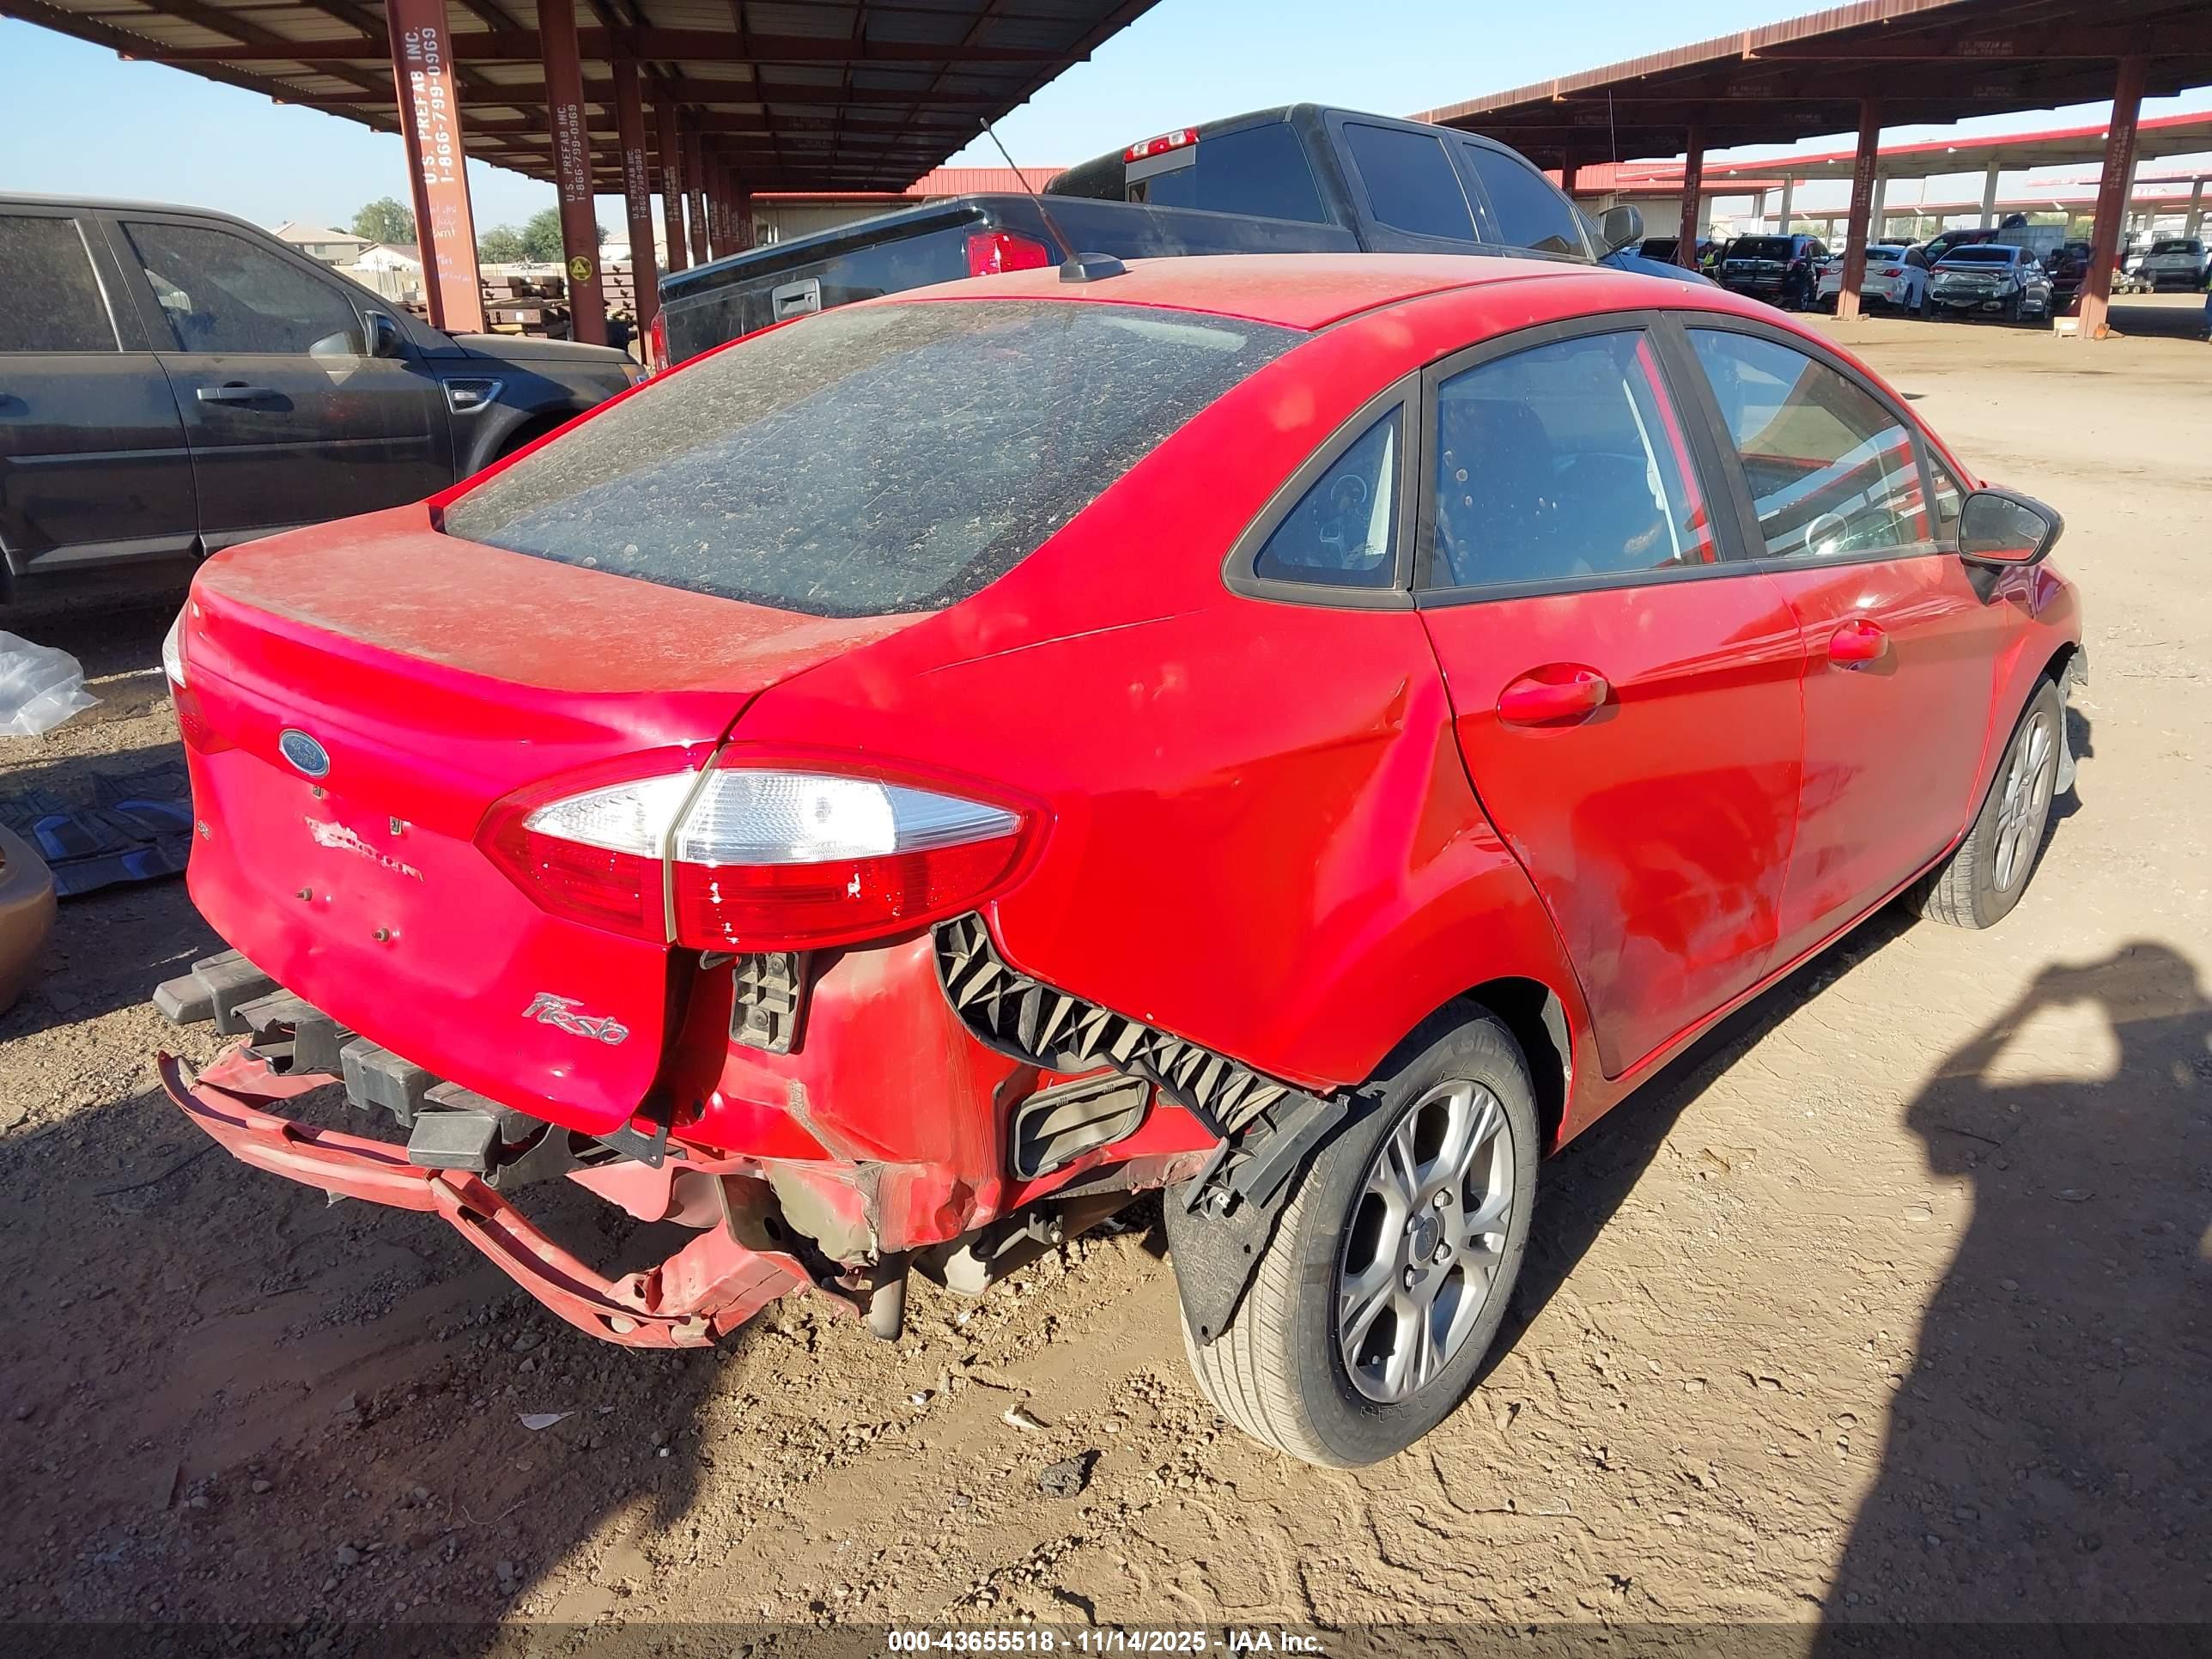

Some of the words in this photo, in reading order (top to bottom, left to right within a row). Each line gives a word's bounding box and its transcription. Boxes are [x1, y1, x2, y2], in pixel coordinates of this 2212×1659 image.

[404, 27, 422, 60] INC.
[410, 71, 432, 140] PREFAB
[421, 27, 455, 183] 1-866-799-0969
[557, 103, 568, 125] INC.
[422, 152, 438, 183] U.S.
[560, 131, 573, 174] PREFAB
[568, 104, 586, 200] 1-866-799-0969
[566, 181, 576, 202] U.S.
[521, 992, 629, 1045] Fiesta
